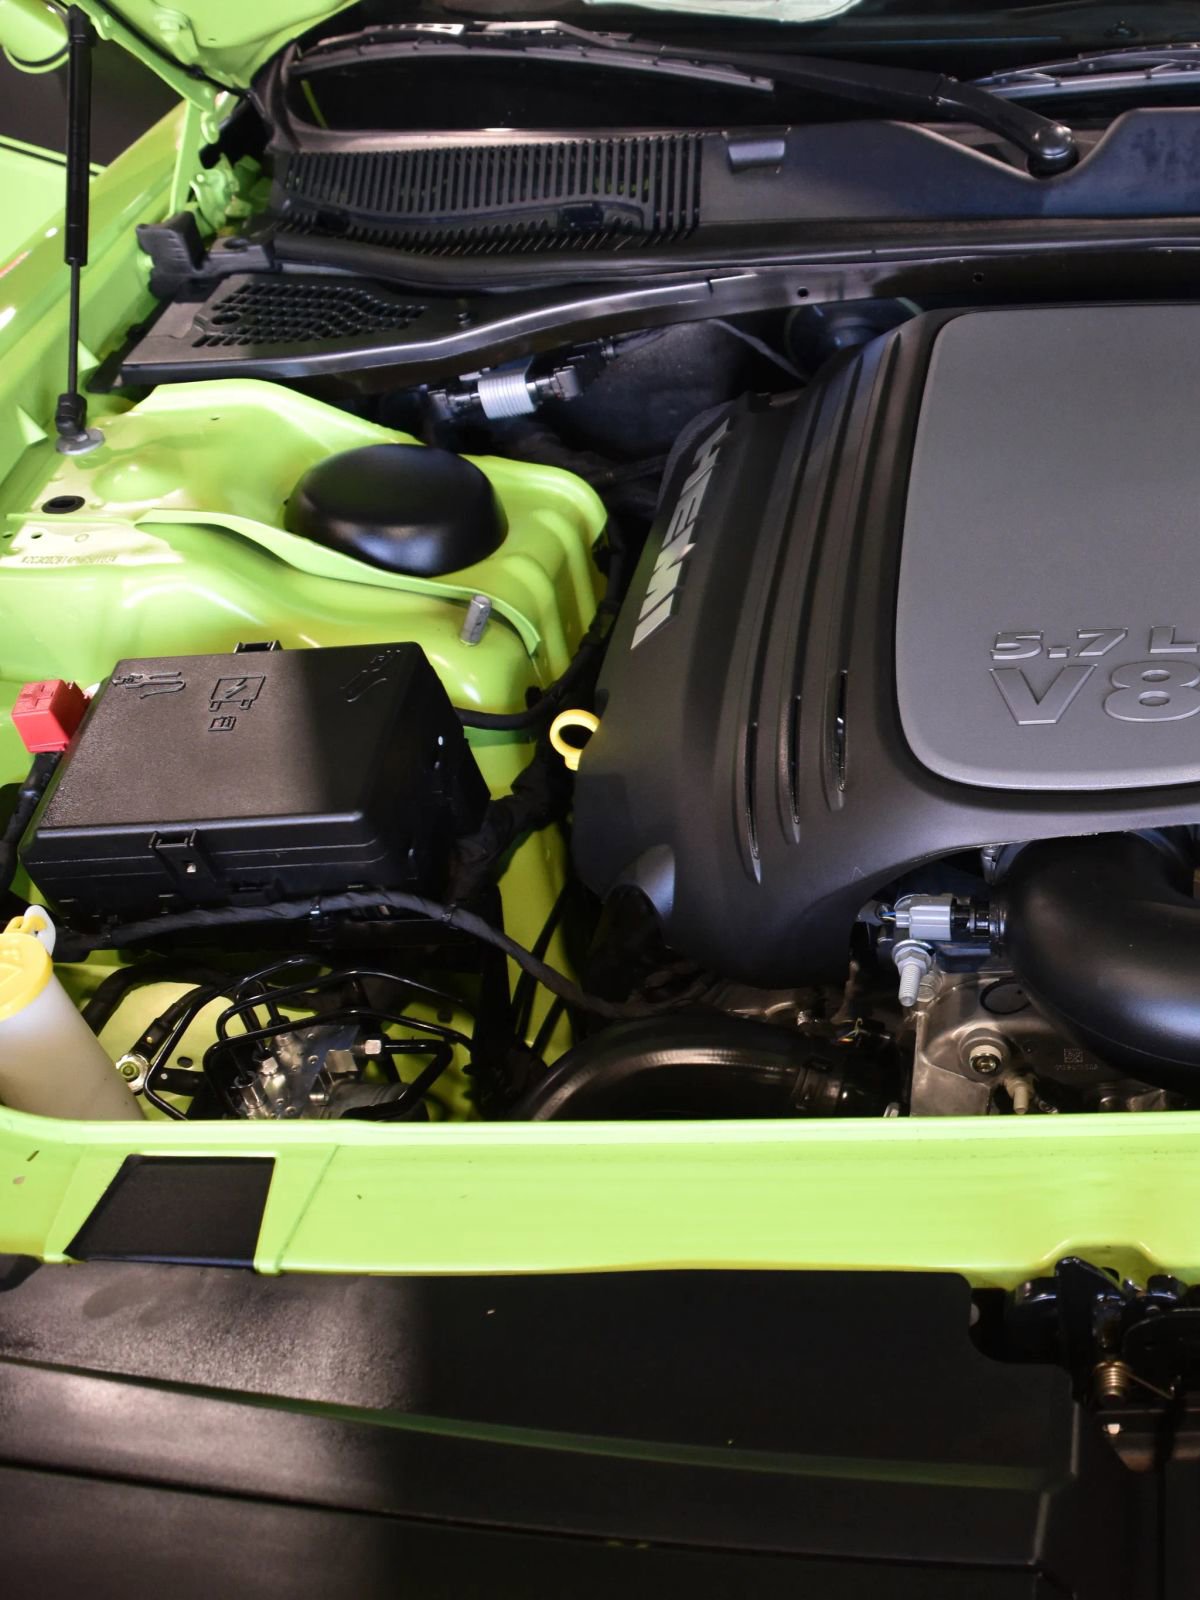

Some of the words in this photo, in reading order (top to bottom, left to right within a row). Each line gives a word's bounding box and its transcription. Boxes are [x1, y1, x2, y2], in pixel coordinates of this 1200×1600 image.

[630, 417, 730, 650] HEMI
[990, 628, 1128, 660] 5.7
[1150, 625, 1199, 654] L
